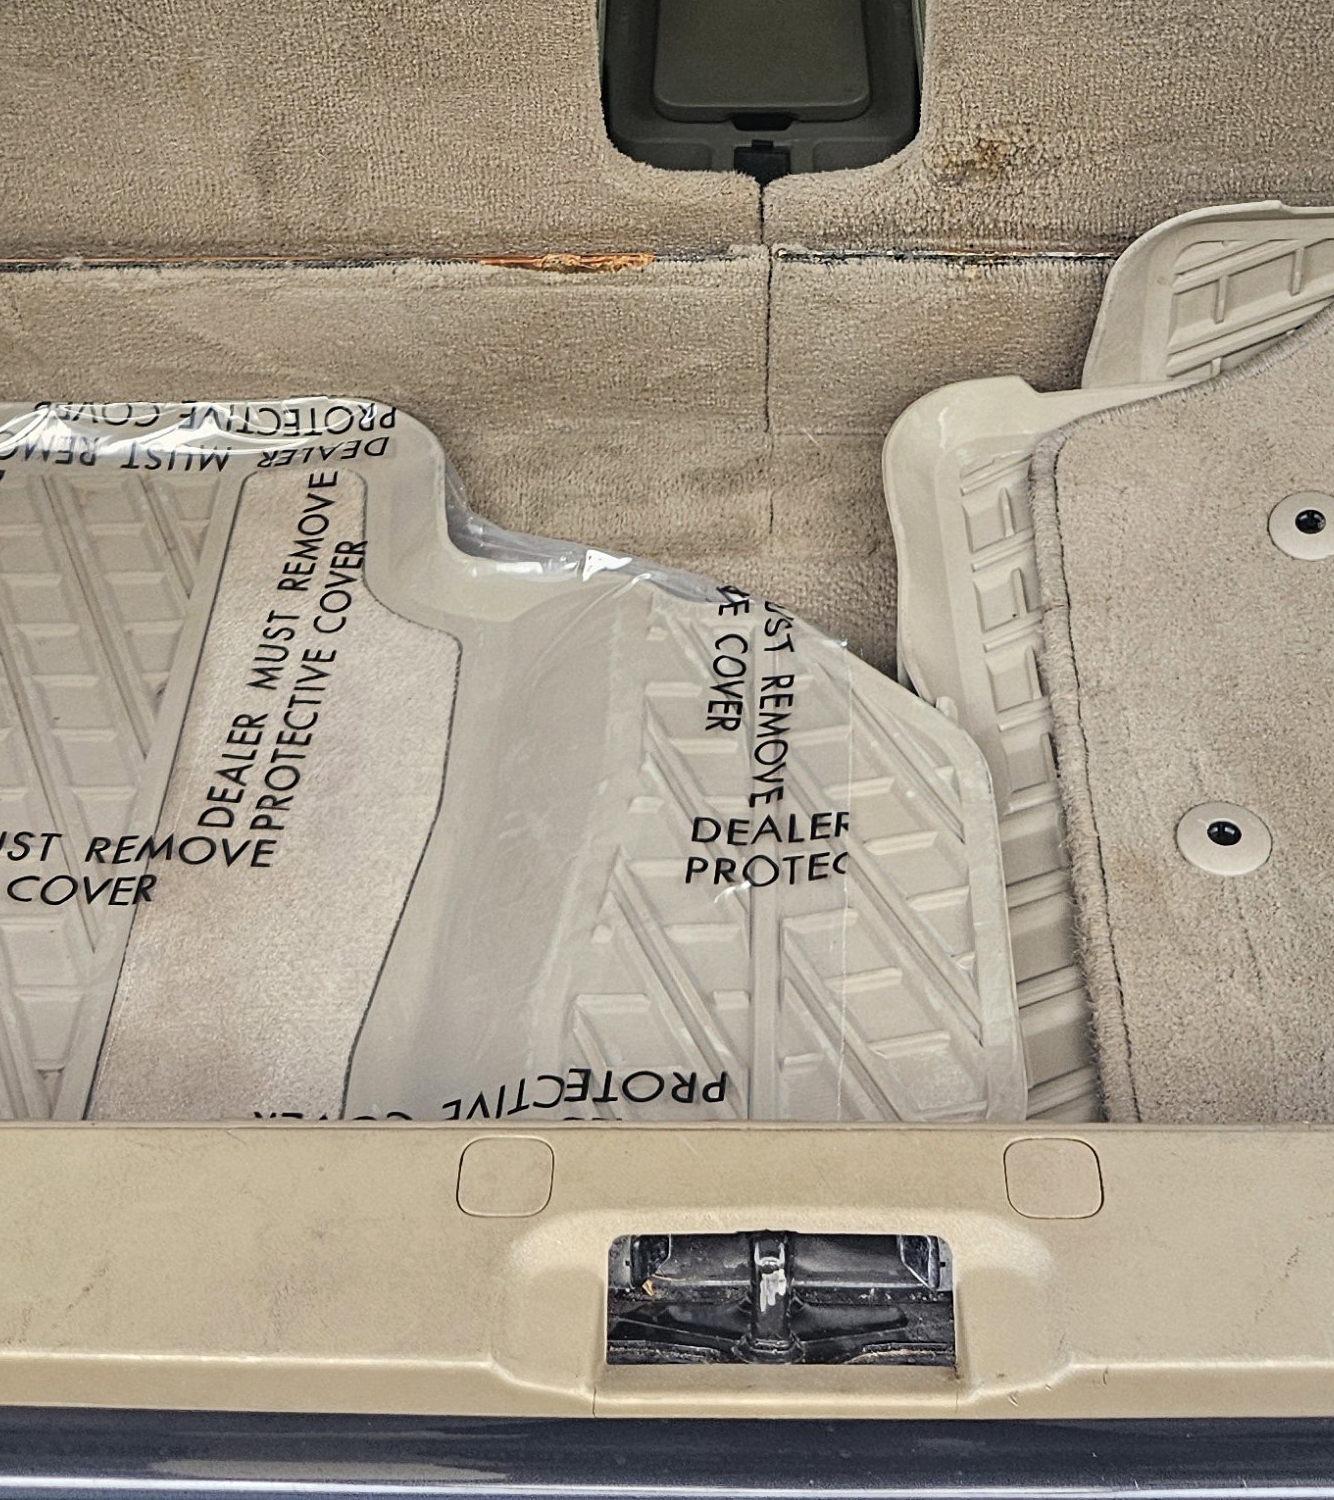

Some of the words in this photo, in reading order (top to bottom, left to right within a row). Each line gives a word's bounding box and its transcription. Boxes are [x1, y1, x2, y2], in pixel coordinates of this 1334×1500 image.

[121, 442, 232, 472] MUST
[257, 437, 390, 468] DEALER
[197, 713, 269, 829] DEALER
[247, 609, 301, 691] MUST
[276, 470, 339, 592] REMOVE
[705, 633, 749, 731] COVER
[249, 649, 338, 831] PROTECTIVE
[313, 540, 369, 634] COVER
[748, 674, 795, 808] REMOVE
[85, 835, 278, 869] REMOVE
[7, 873, 160, 907] COVER
